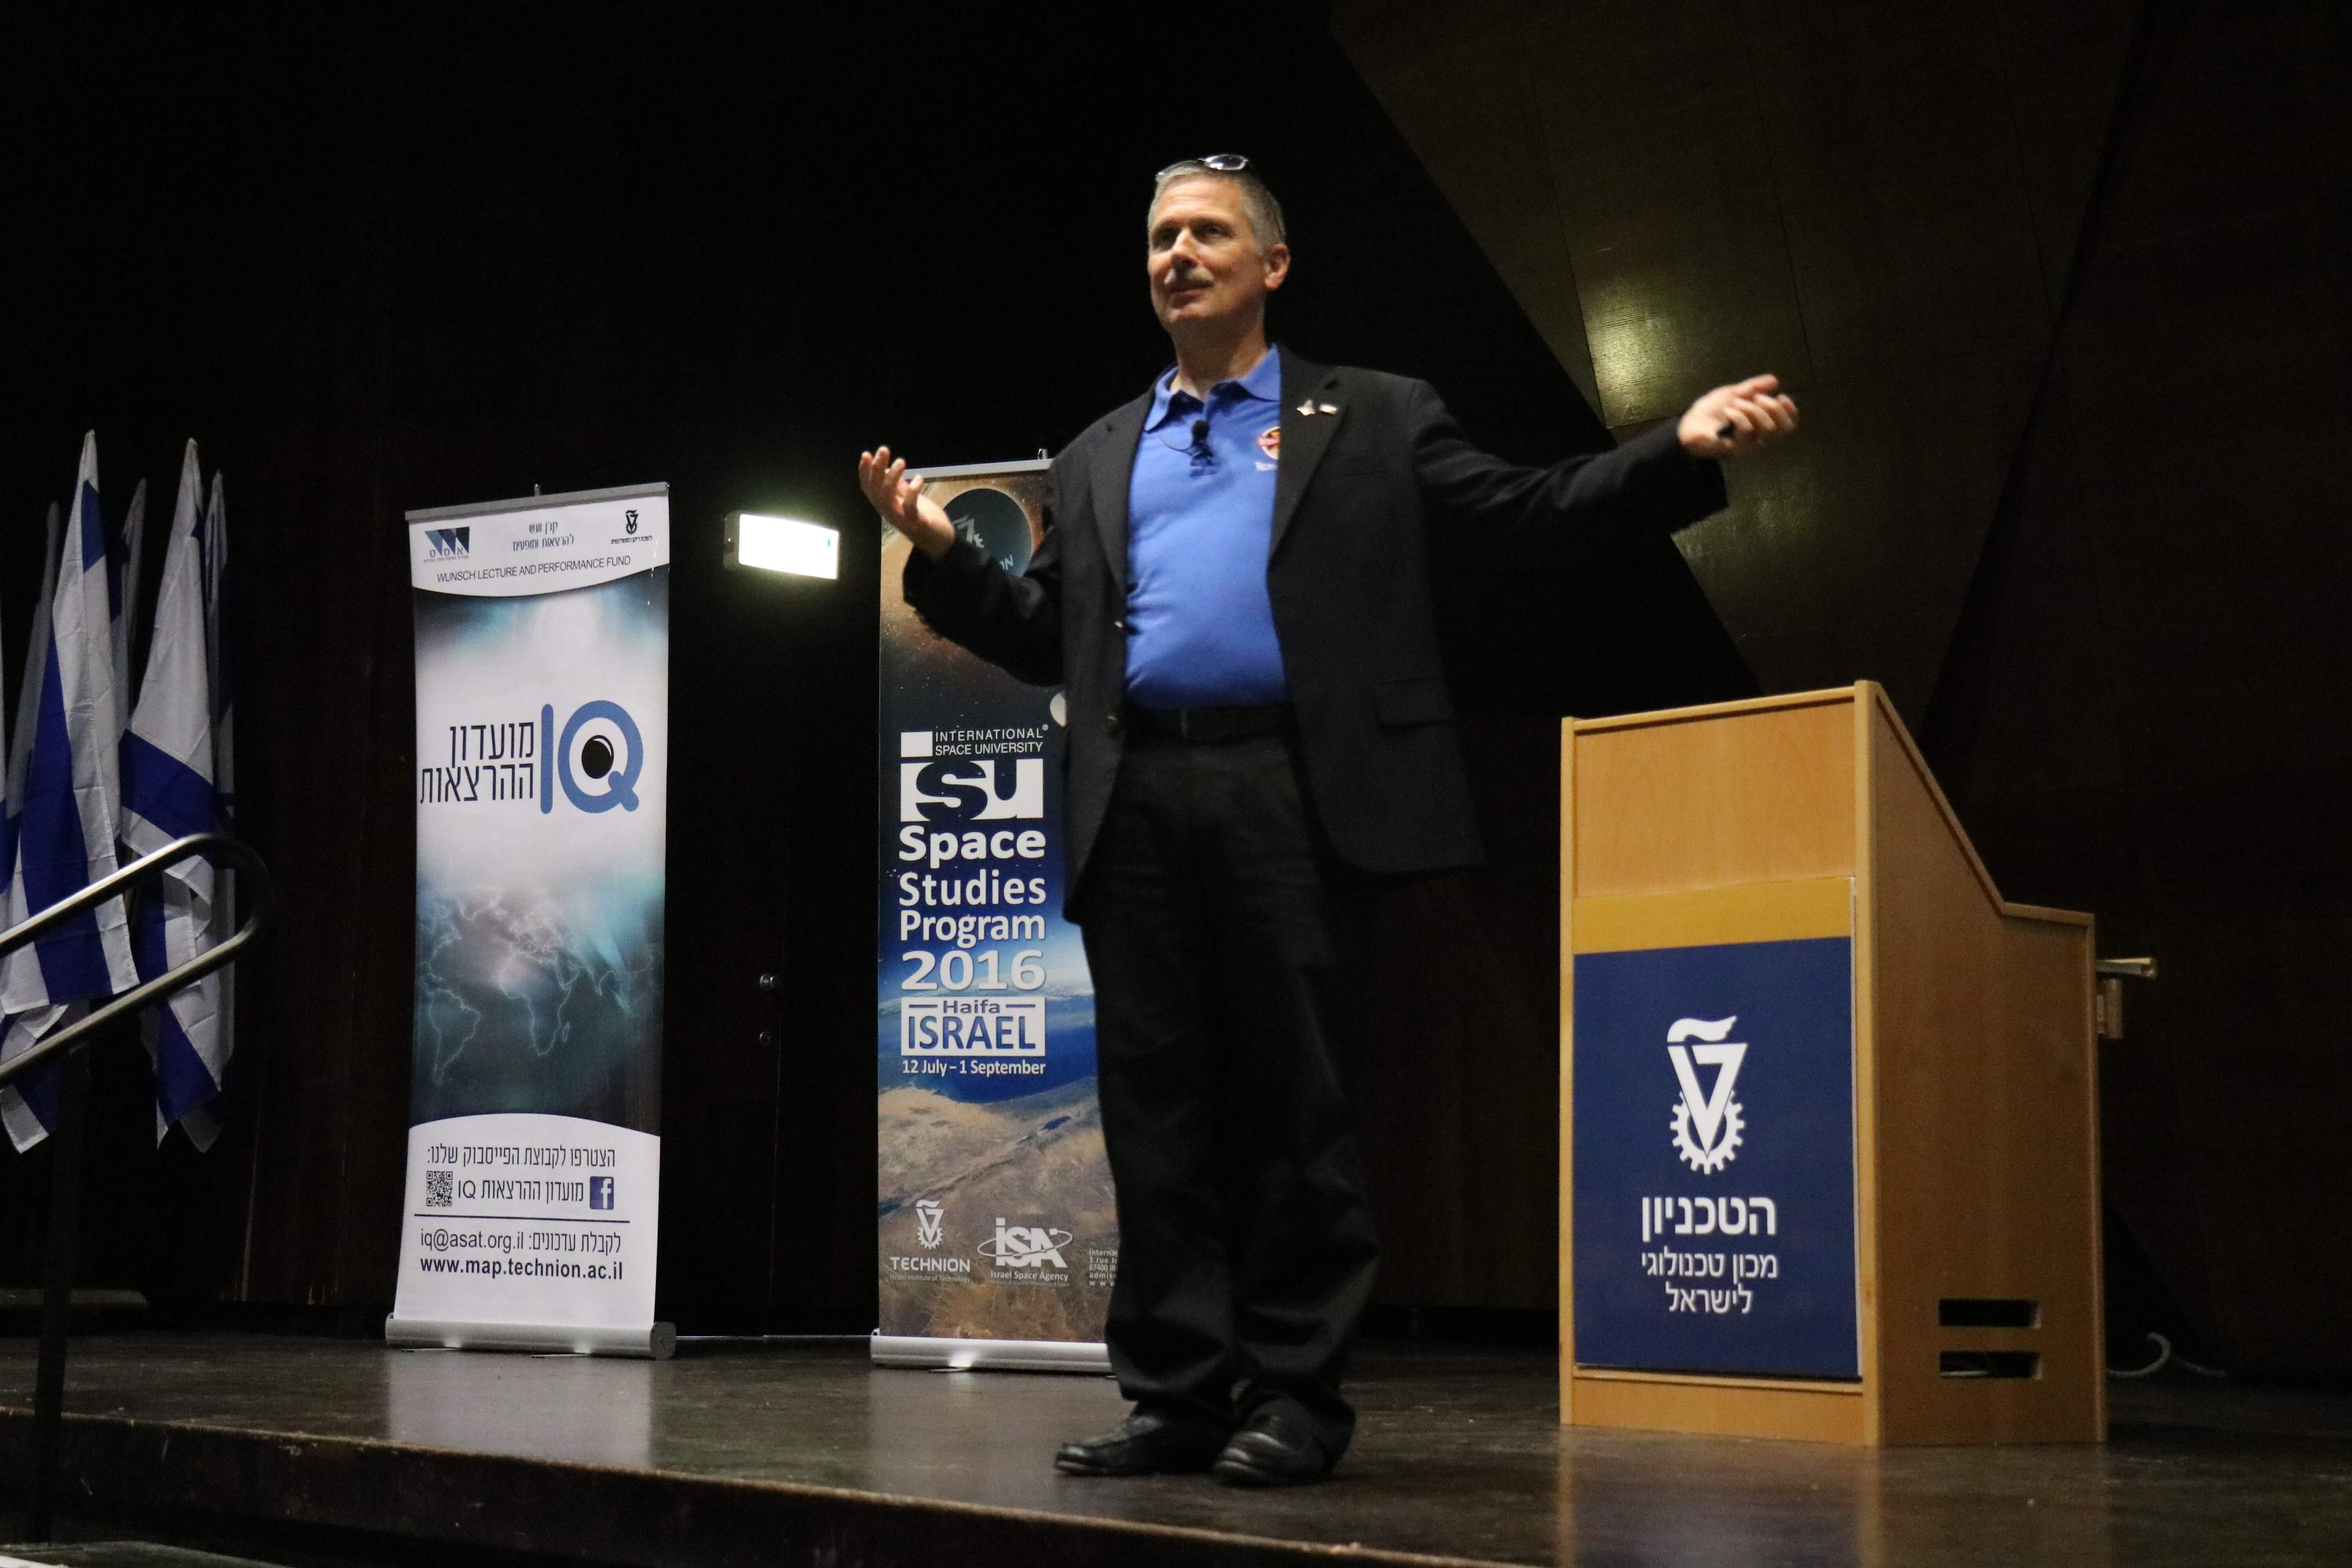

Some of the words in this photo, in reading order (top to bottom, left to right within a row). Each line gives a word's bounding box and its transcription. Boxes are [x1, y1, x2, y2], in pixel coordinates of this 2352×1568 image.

[545, 521, 558, 535] קרן
[513, 539, 539, 551] ומופעים
[542, 533, 574, 548] להרצאות
[437, 571, 475, 583] WUNSCH
[478, 567, 517, 579] LECTURE
[519, 564, 536, 575] AND
[538, 558, 604, 573] PERFORMANCE
[607, 555, 631, 567] FUND
[450, 722, 534, 768] מועדון
[935, 744, 971, 756] SPACE
[975, 742, 1043, 755] UNIVERSITY
[540, 700, 644, 815] IQ
[420, 763, 534, 804] ההרצאות
[899, 825, 1046, 869] Space
[899, 869, 1046, 907] Studies
[900, 910, 1046, 949] Program
[901, 949, 1046, 990] 2016
[943, 1000, 1001, 1014] Haifa
[908, 1016, 1036, 1050] ISRAEL
[902, 1060, 918, 1074] 12
[921, 1060, 947, 1077] July
[960, 1060, 967, 1074] 1
[971, 1060, 1046, 1078] September
[427, 1143, 458, 1165] שלנו:
[463, 1145, 519, 1167] הפייסבוק
[524, 1145, 567, 1169] לקבוצת
[570, 1148, 615, 1167] הצטרפו
[458, 1180, 476, 1199] IQ
[481, 1179, 541, 1201] ההרצאות
[546, 1181, 584, 1204] מועדון
[1642, 1196, 1777, 1242] הטכניון
[420, 1228, 524, 1252] iq@asat.org.il
[528, 1231, 576, 1252] עדכונים:
[581, 1231, 621, 1256] לקבלת
[420, 1257, 623, 1280] www.map.technion.ac.il
[889, 1257, 971, 1273] TECHNION
[1641, 1245, 1724, 1277] טכנולוגי
[1733, 1254, 1779, 1285] מכון
[991, 1270, 1012, 1278] Israel
[1014, 1270, 1037, 1281] Space
[1040, 1272, 1069, 1282] Agency
[1665, 1281, 1753, 1314] לישראל
